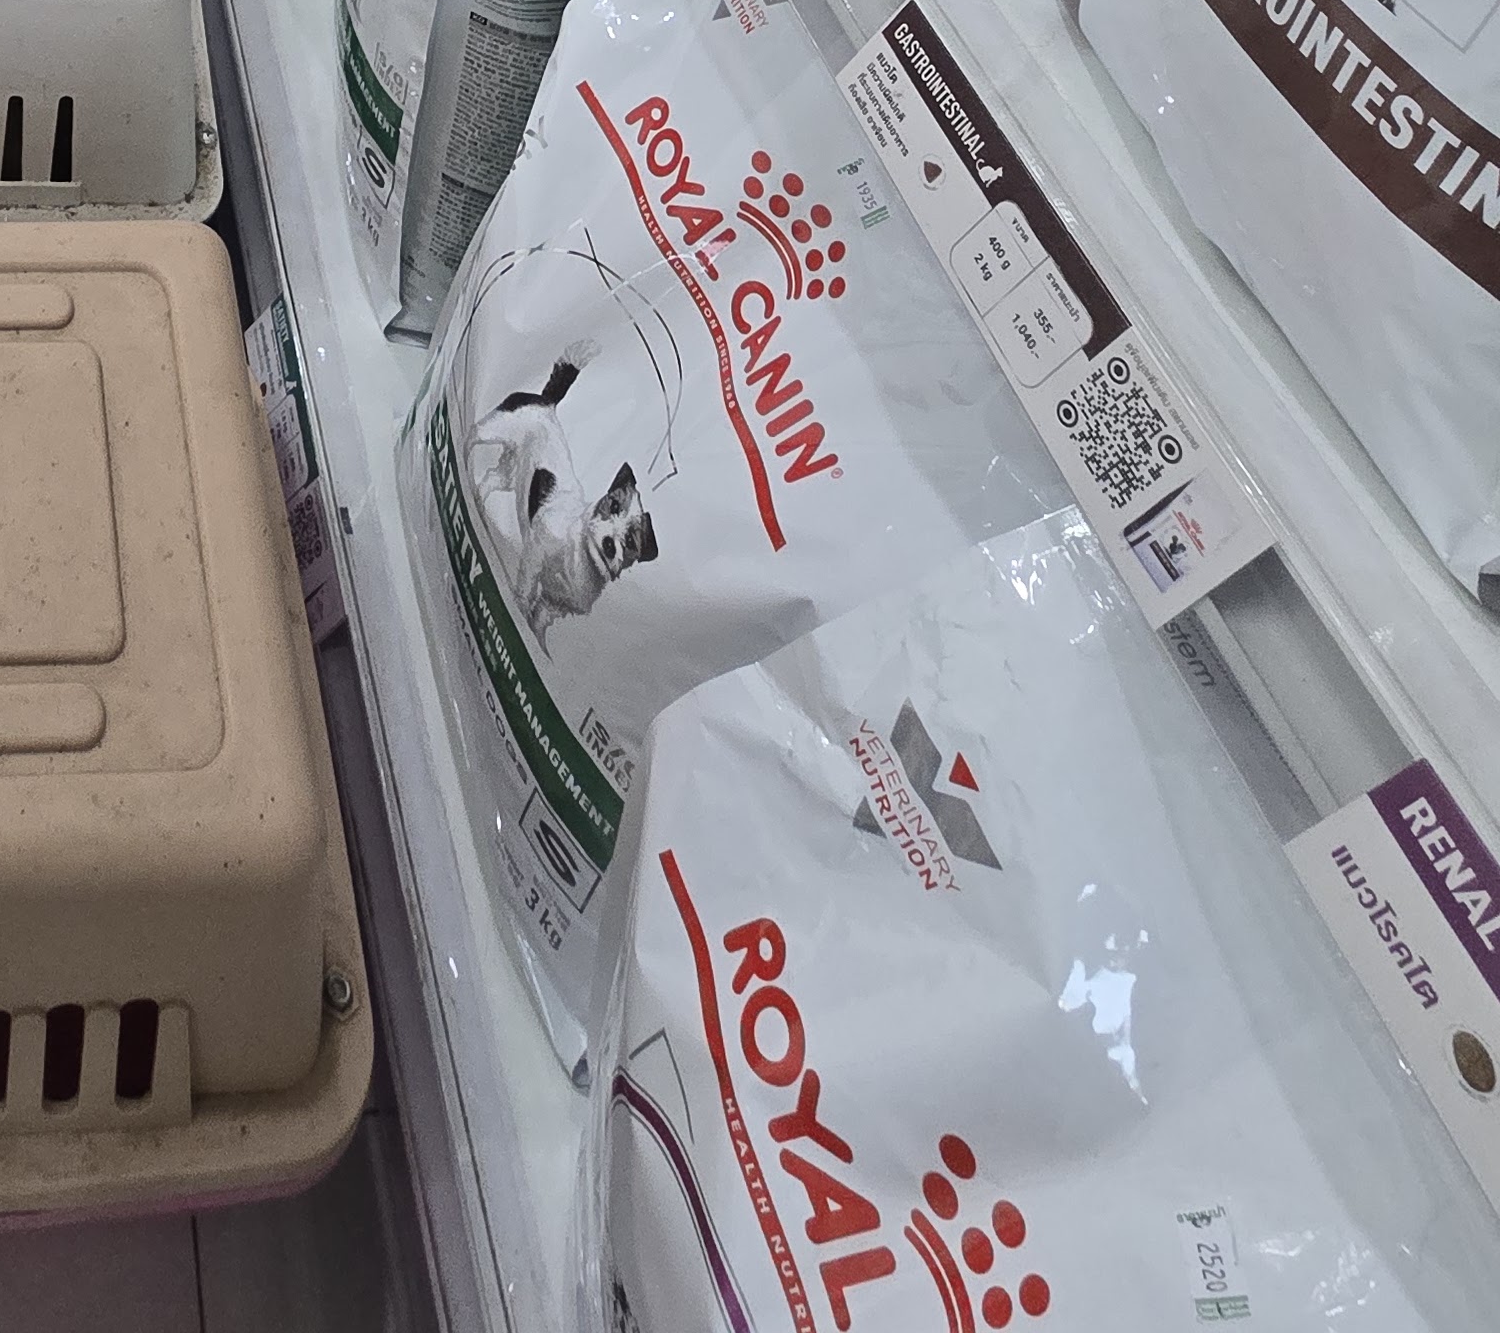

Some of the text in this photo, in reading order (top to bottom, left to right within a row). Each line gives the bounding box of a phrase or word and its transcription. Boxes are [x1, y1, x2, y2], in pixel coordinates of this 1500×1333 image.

[894, 23, 985, 160] GASTROINTESTINAL
[625, 93, 737, 283] ROYAL
[855, 180, 879, 211] 1935
[988, 236, 1012, 271] 400 g
[638, 195, 665, 246] HEALTH
[715, 334, 730, 373] SINCE
[973, 253, 993, 282] 2 kg
[477, 591, 518, 691] WEIGHT
[512, 686, 615, 839] MANAGEMENT
[847, 734, 940, 891] NUTRITION
[857, 717, 961, 895] VETERINARY
[1399, 796, 1500, 953] RENAL
[524, 888, 563, 951] 3 kg
[722, 916, 898, 1332] ROYAL
[723, 1096, 771, 1219] HEALTH
[1194, 1241, 1229, 1292] 2520
